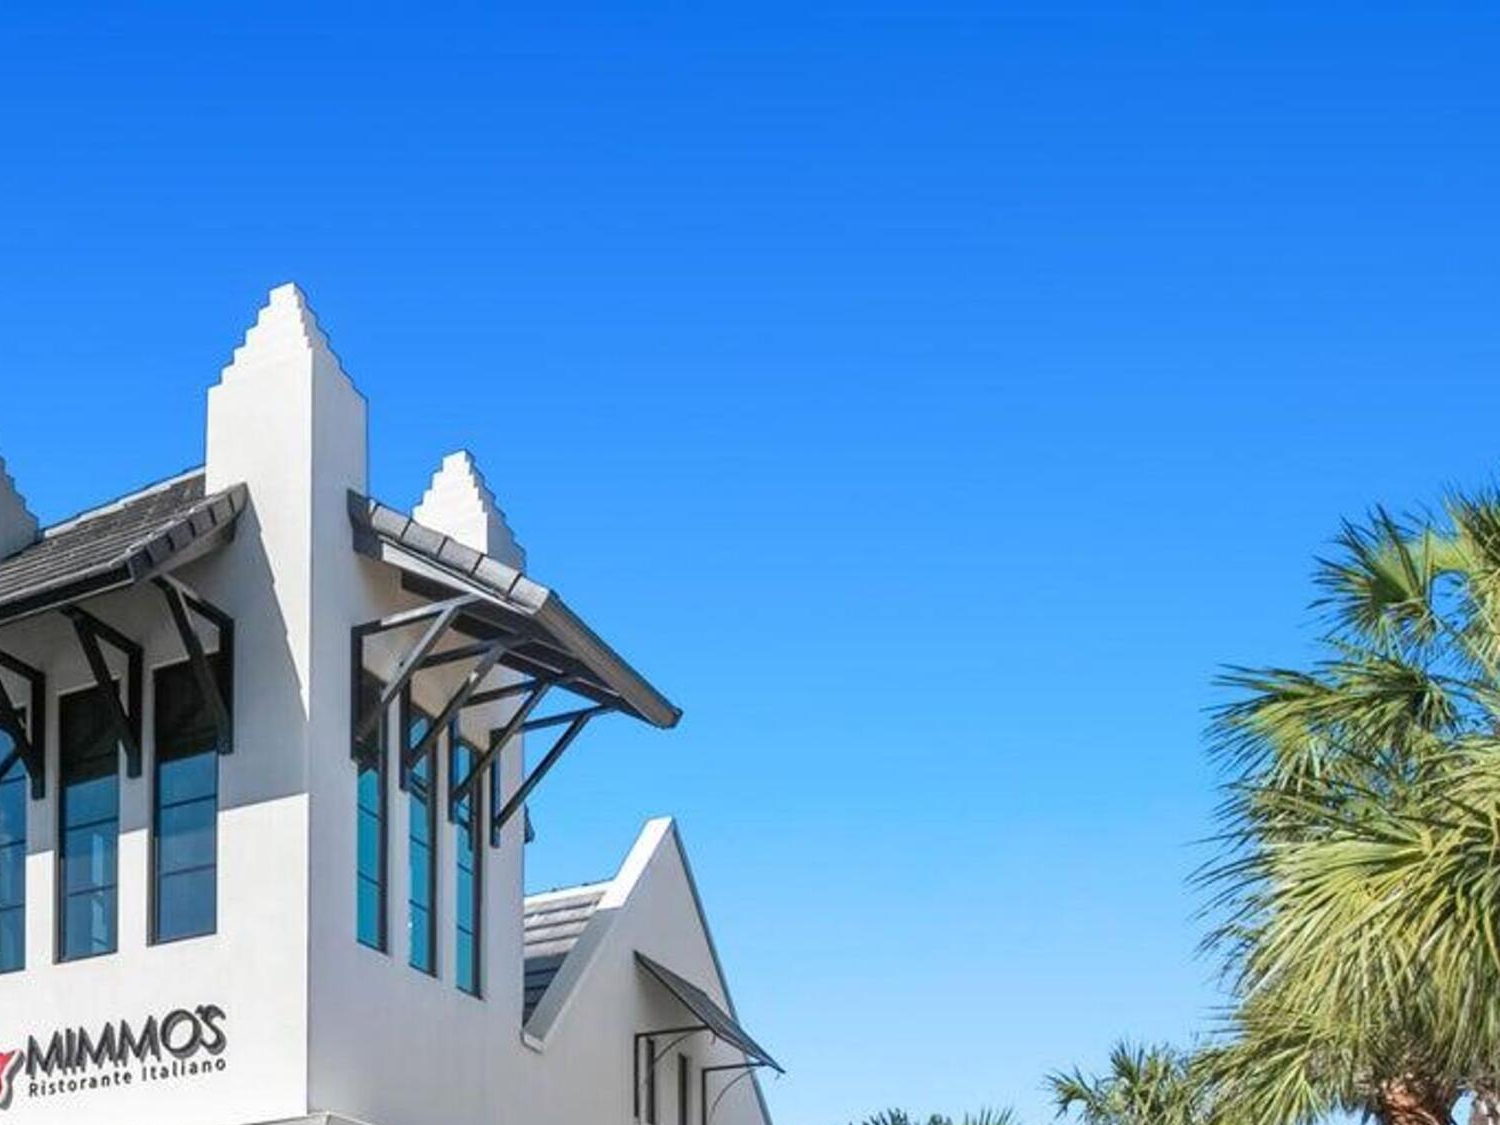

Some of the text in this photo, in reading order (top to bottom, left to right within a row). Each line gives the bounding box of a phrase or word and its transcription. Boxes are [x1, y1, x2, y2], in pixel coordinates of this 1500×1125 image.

[25, 1004, 227, 1078] MIMMO'S
[28, 1058, 226, 1098] Ristorante Italiano
